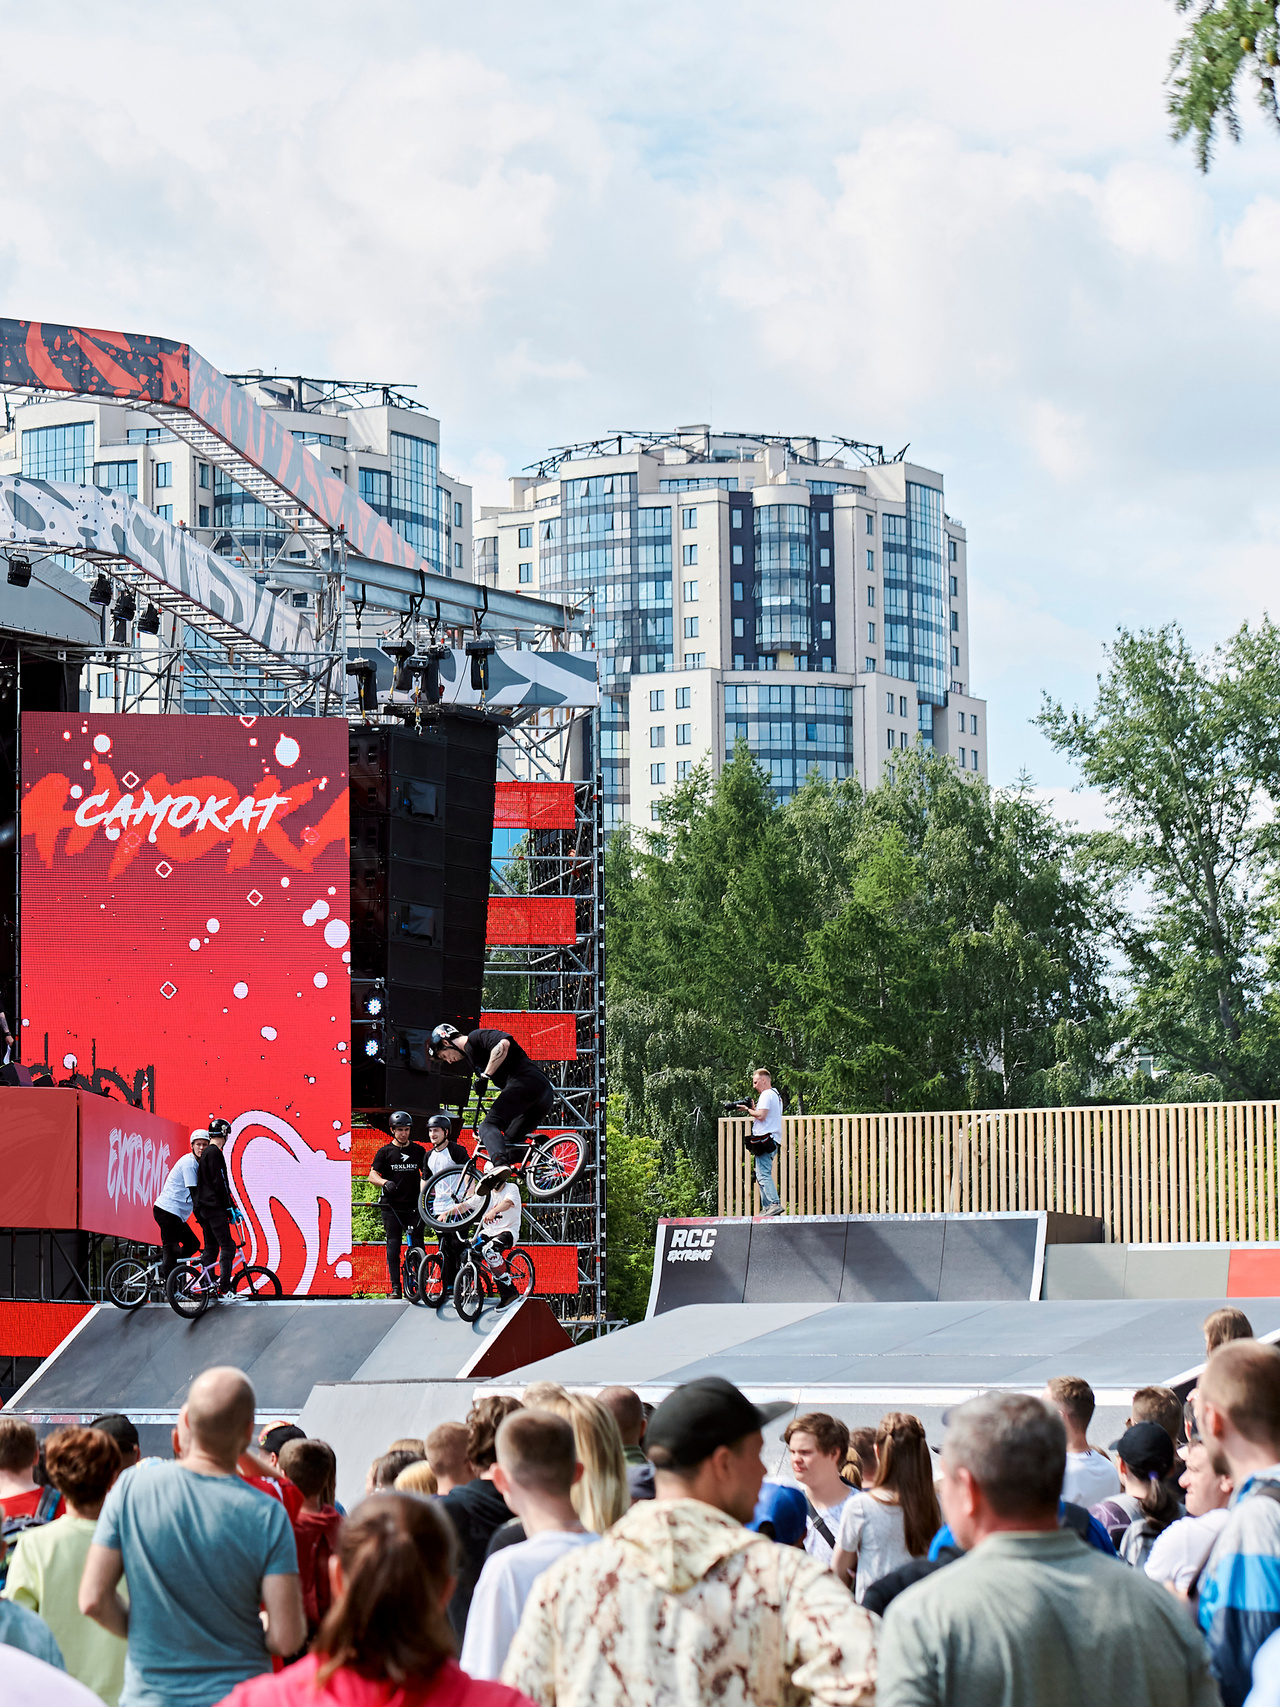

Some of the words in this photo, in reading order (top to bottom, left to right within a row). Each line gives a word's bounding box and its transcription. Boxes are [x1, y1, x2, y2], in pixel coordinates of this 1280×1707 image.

[75, 788, 292, 834] САМОКАТ
[670, 1229, 717, 1248] RCC
[667, 1249, 713, 1263] EXTREME
